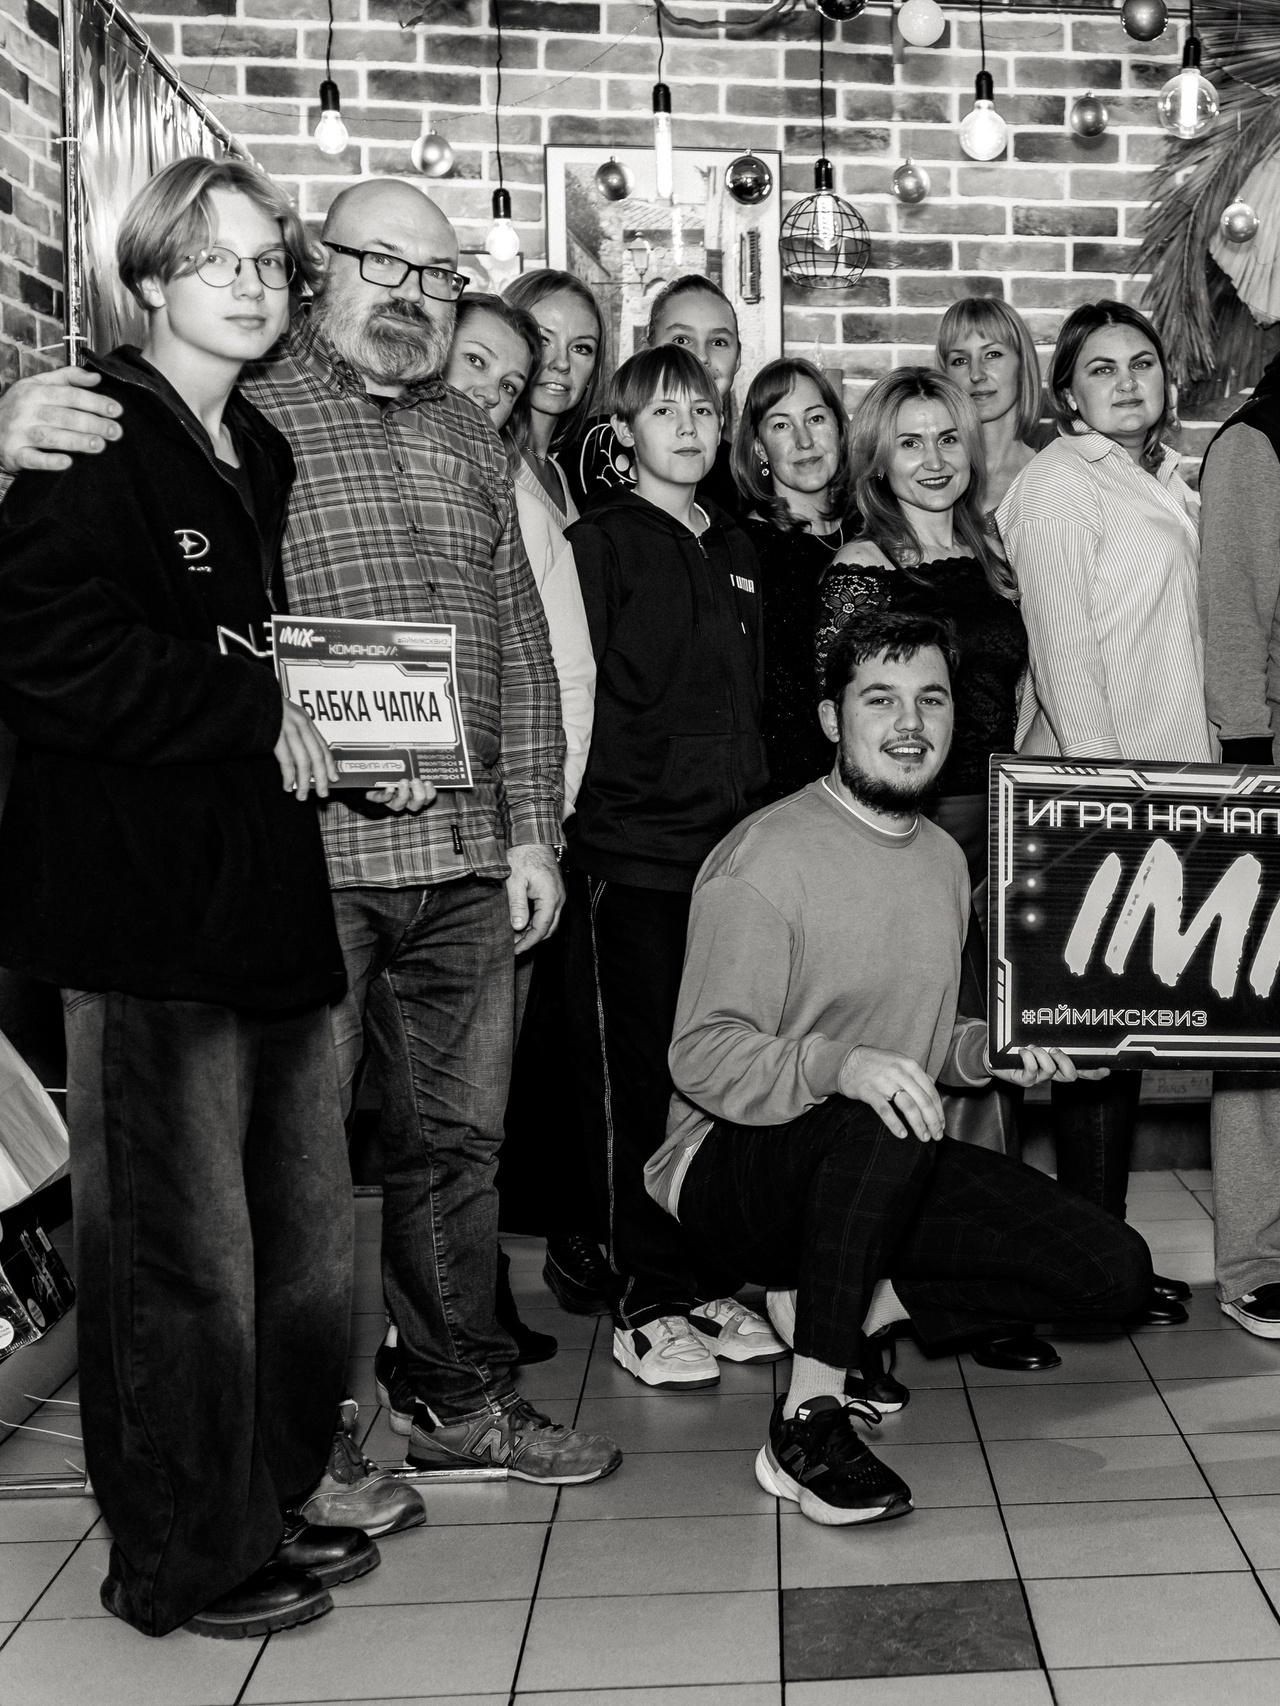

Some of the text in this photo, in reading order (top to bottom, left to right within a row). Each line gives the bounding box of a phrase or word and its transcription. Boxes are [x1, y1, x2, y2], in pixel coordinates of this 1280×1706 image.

[298, 689, 442, 722] БАБКА ЧАПКА
[1028, 799, 1133, 831] ИГРА
[1021, 1004, 1208, 1028] #АЙМИКСКВИЗ
